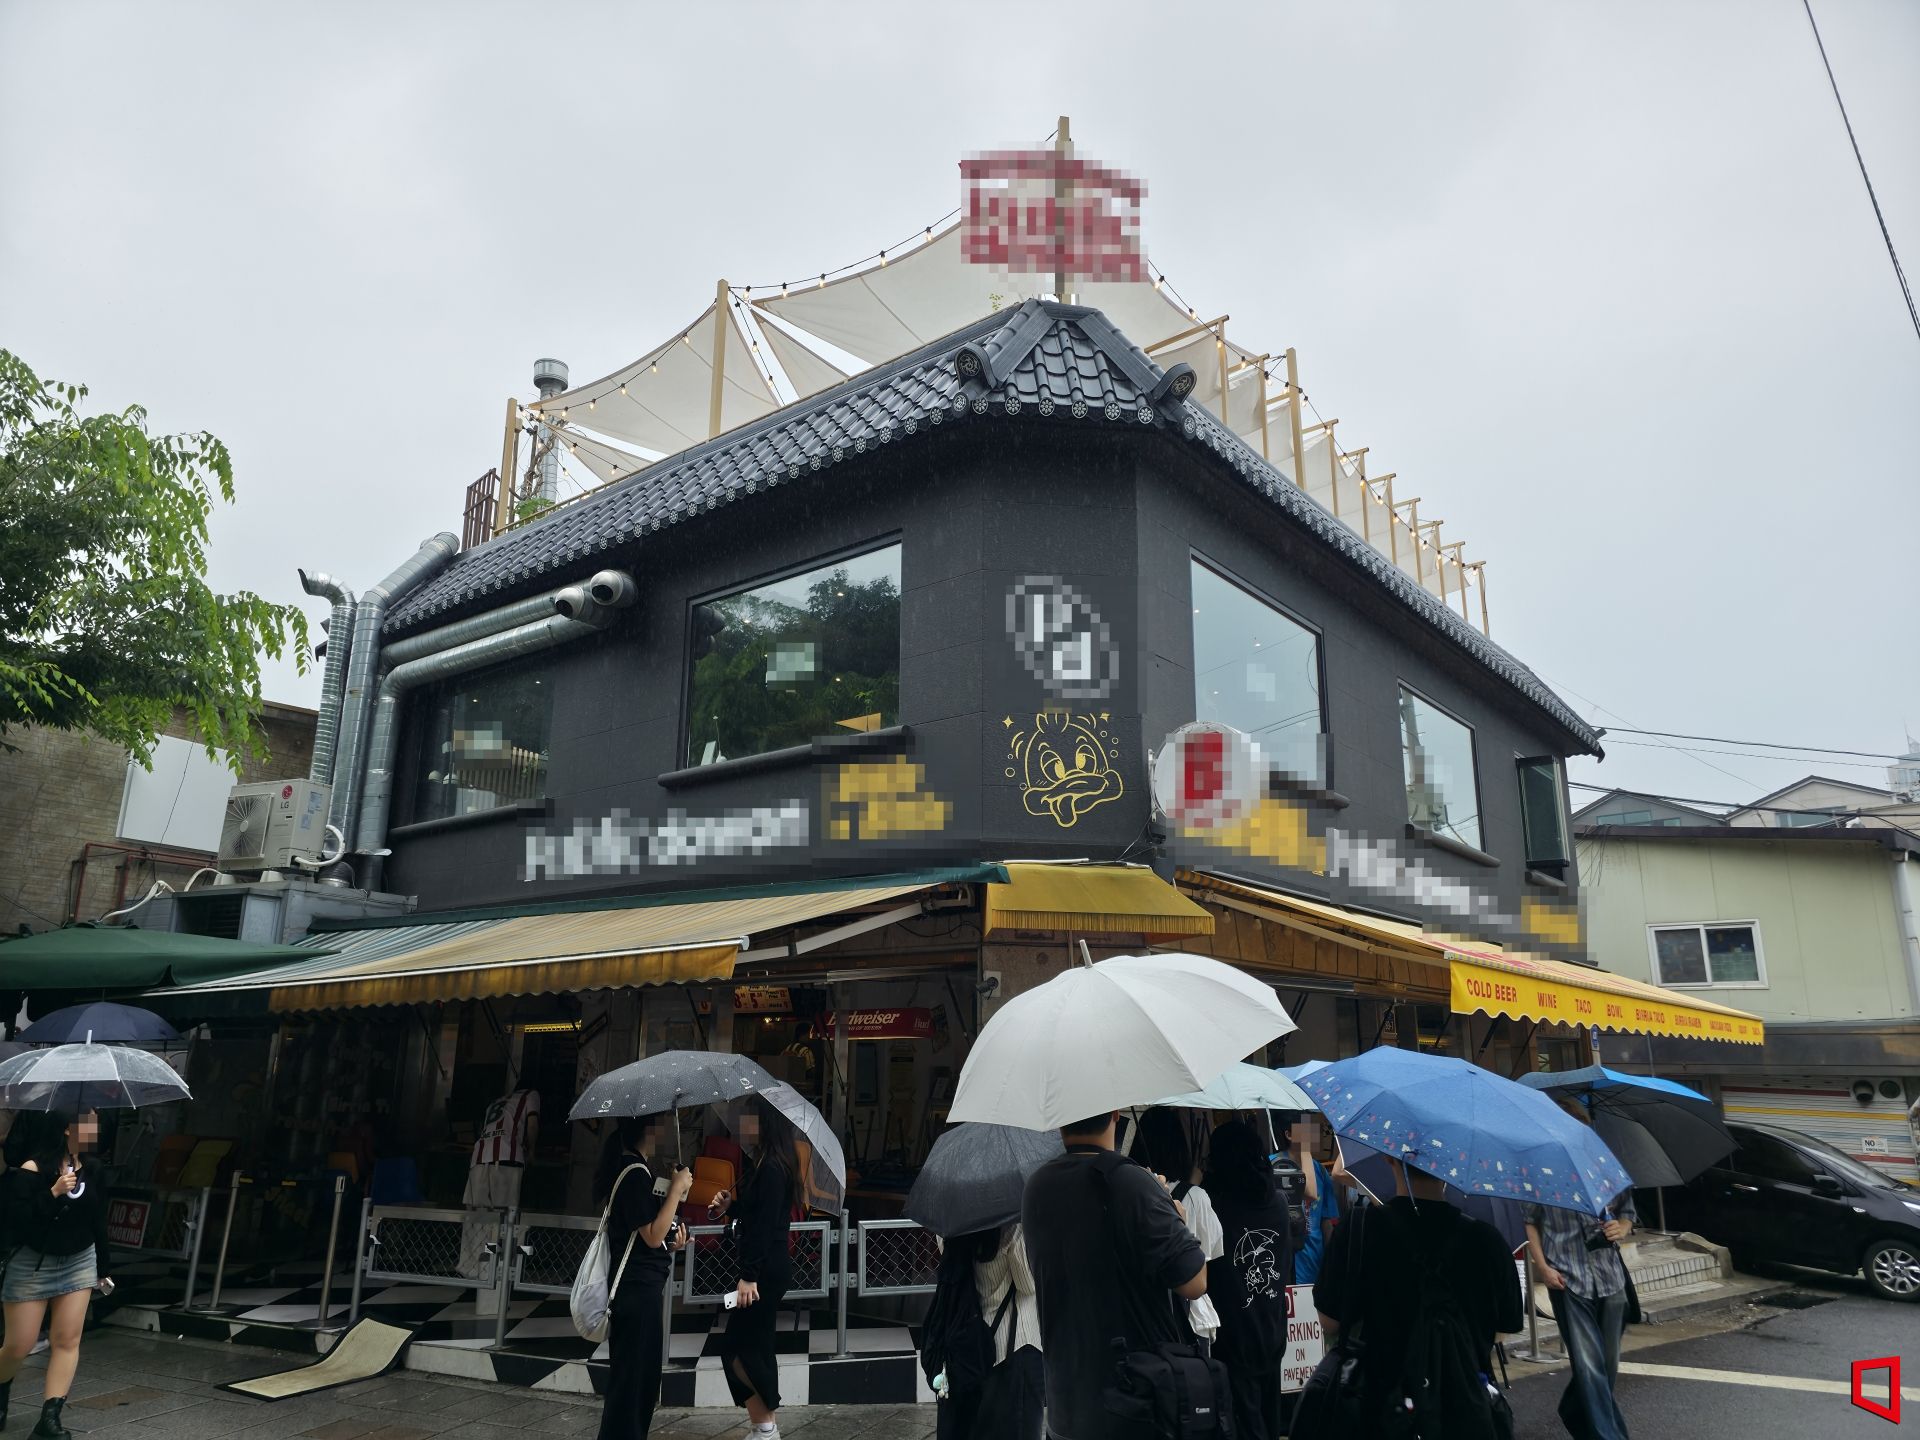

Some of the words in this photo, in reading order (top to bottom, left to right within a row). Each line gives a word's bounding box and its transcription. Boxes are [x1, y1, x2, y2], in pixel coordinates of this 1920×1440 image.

[280, 801, 290, 809] LG
[1466, 978, 1492, 999] COLD
[1494, 983, 1518, 1003] BEER
[1537, 991, 1557, 1009] WINE
[1574, 998, 1592, 1015] TACO
[1606, 1004, 1623, 1019] BOWL
[1864, 1139, 1876, 1147] NO
[111, 1203, 127, 1224] NO
[1295, 1348, 1306, 1361] ON
